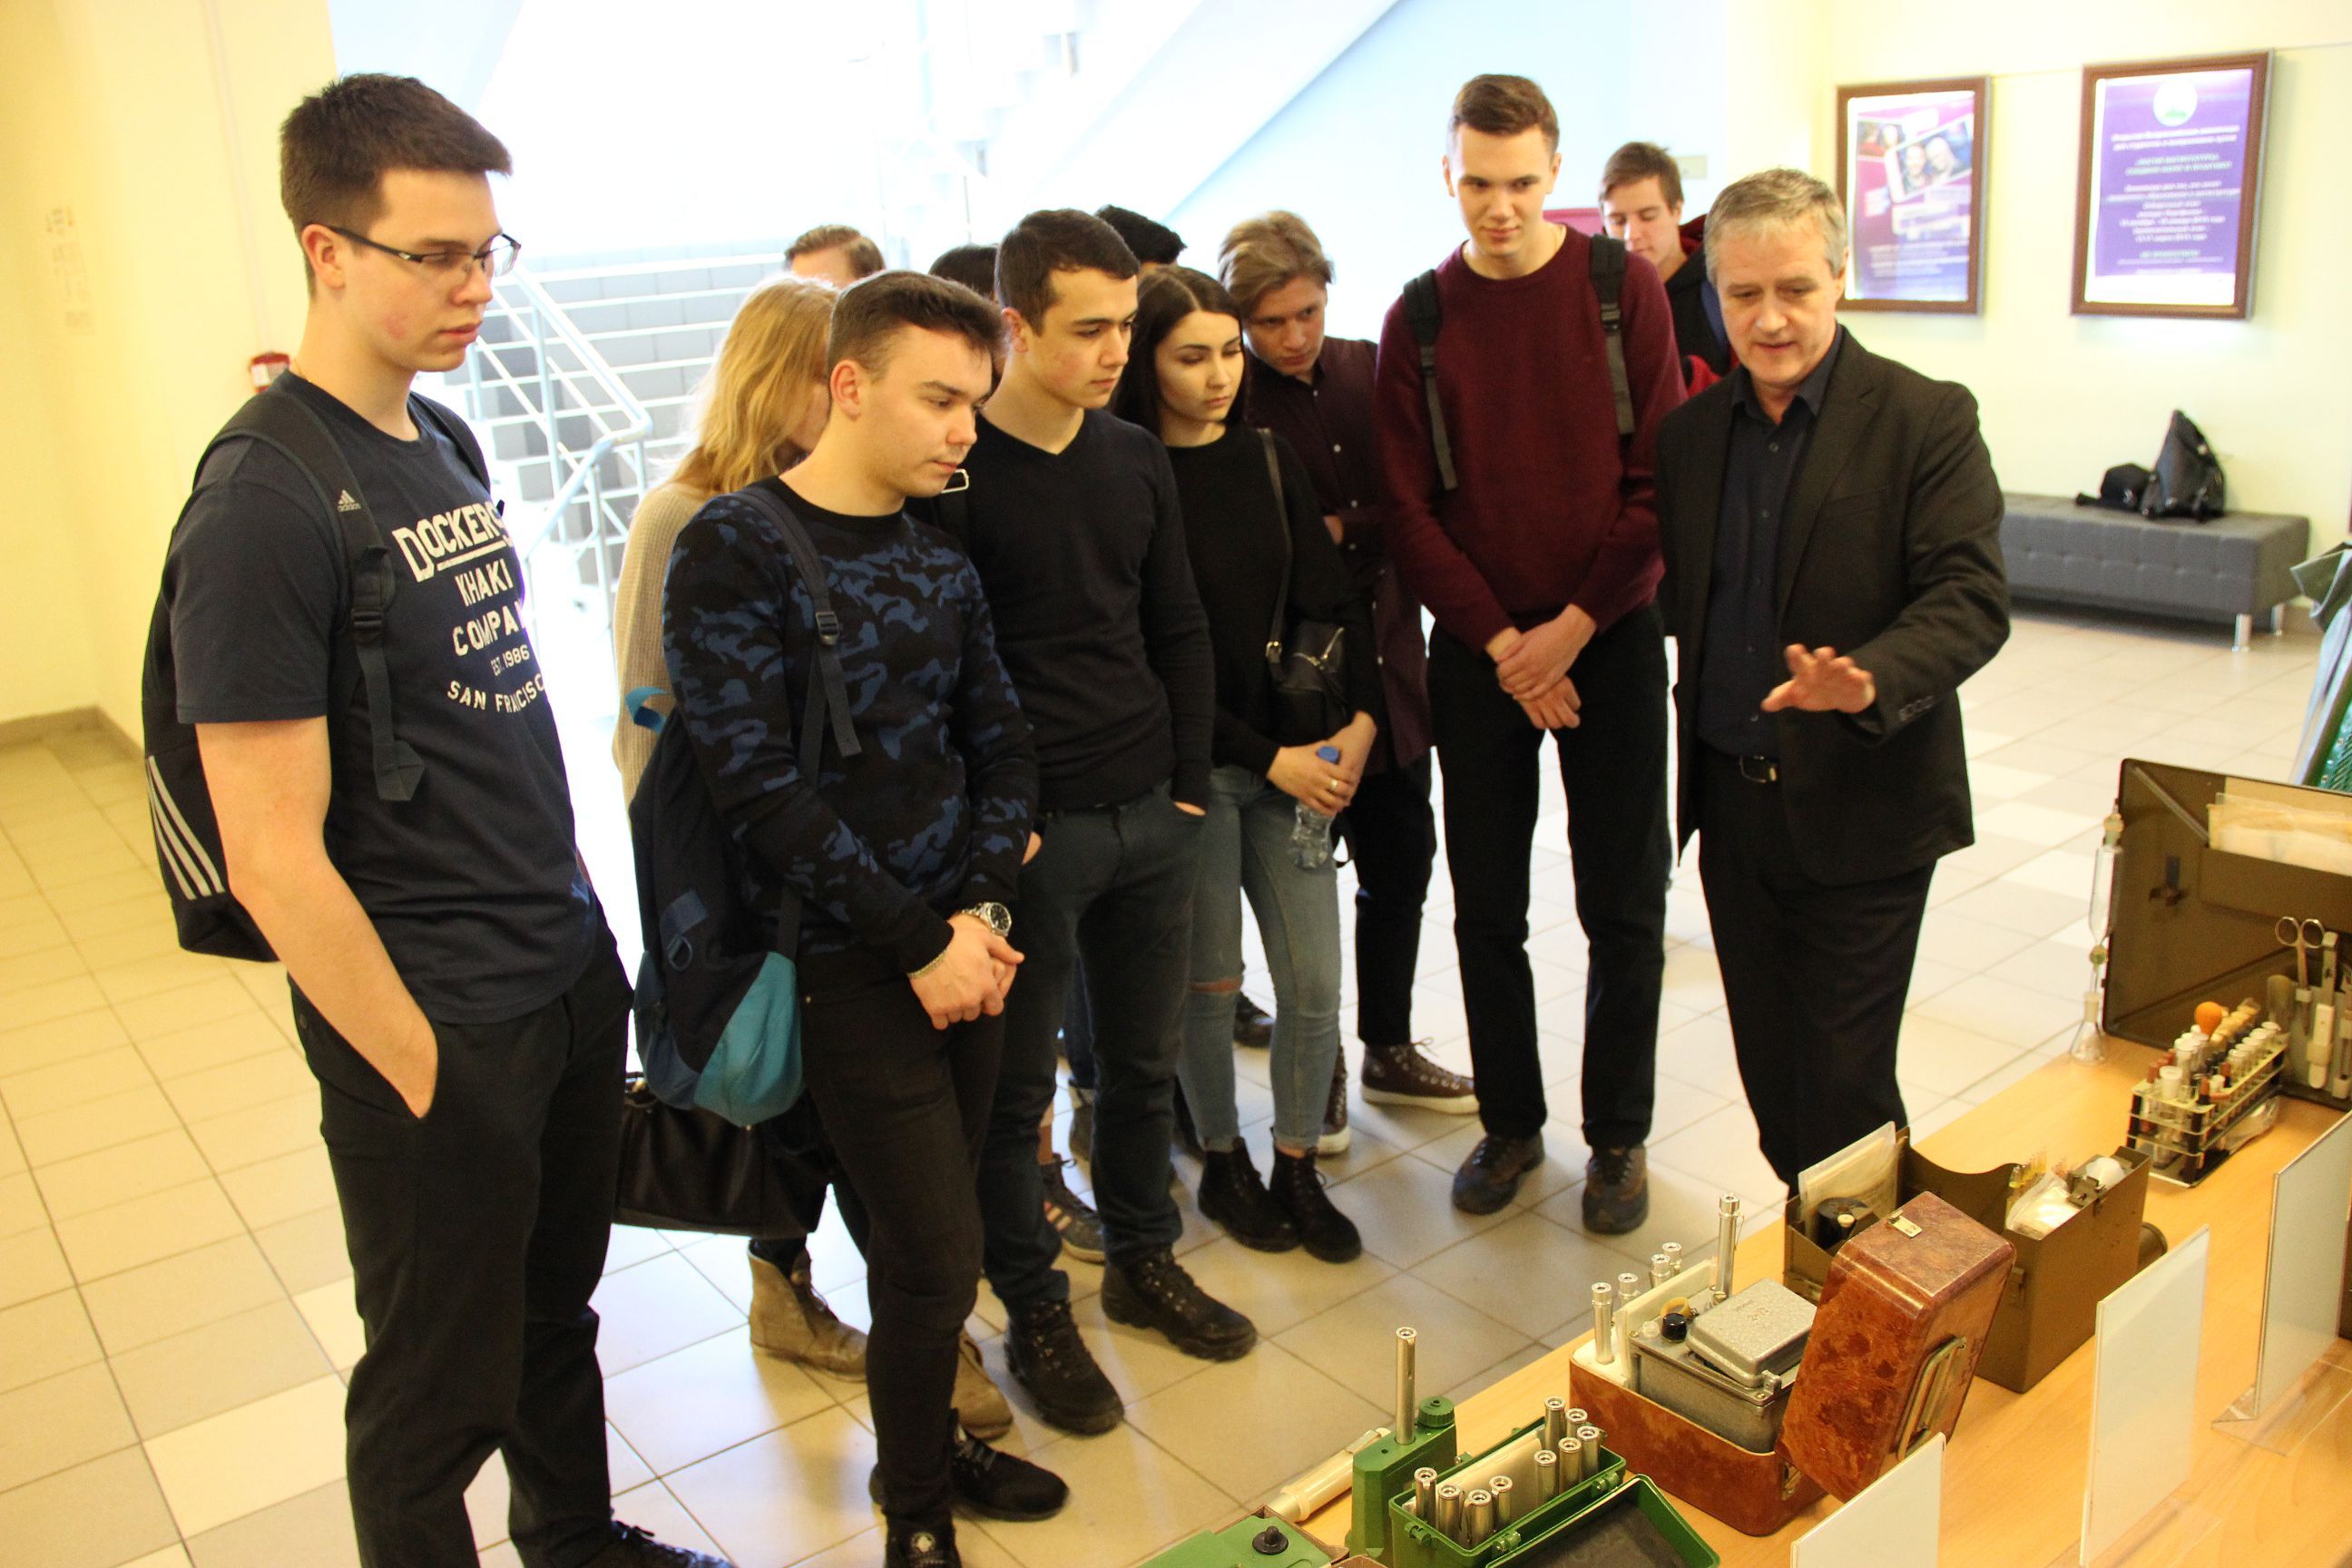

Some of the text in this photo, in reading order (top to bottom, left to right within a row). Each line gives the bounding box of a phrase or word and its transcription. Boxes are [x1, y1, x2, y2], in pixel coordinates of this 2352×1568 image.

[455, 558, 514, 607] KHAKI
[502, 644, 530, 668] 1986
[446, 681, 486, 710] SAN
